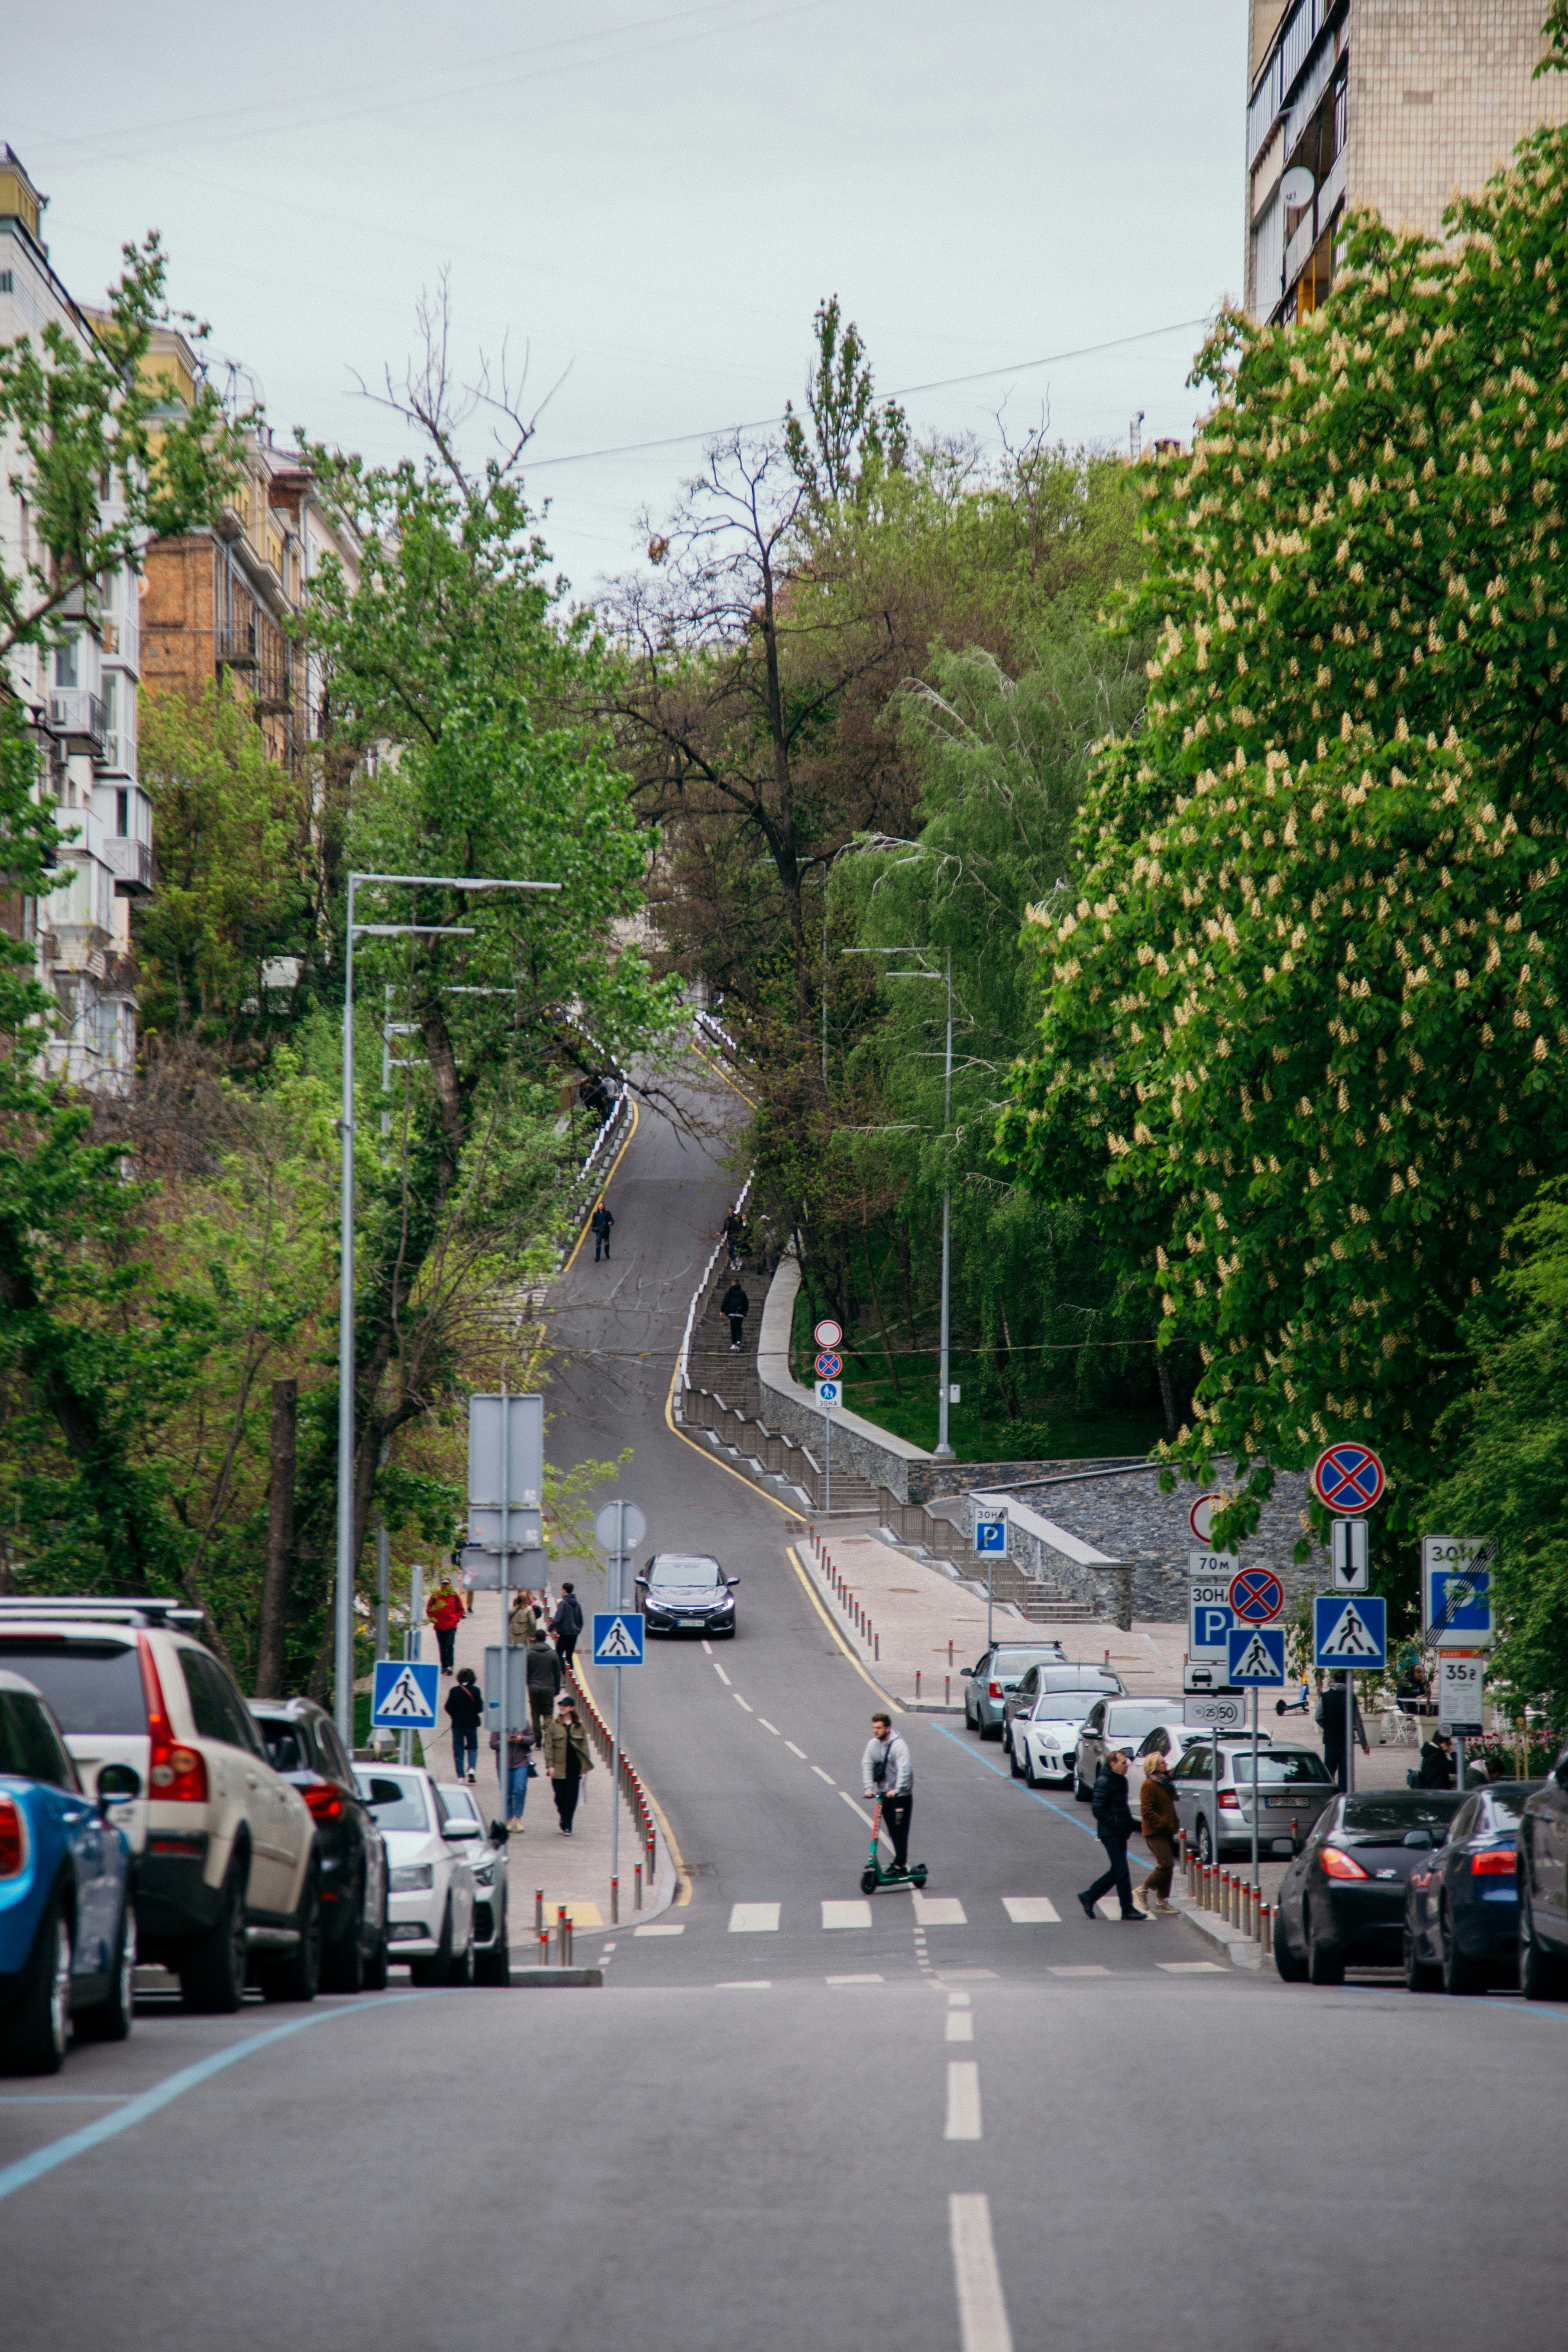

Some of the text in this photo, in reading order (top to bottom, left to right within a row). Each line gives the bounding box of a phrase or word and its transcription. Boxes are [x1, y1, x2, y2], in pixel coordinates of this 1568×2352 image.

[984, 1527, 998, 1547] P
[1193, 1588, 1229, 1602] ЗОН
[1206, 1611, 1226, 1641] P
[1206, 1709, 1216, 1717] 25
[1219, 1707, 1234, 1718] 50
